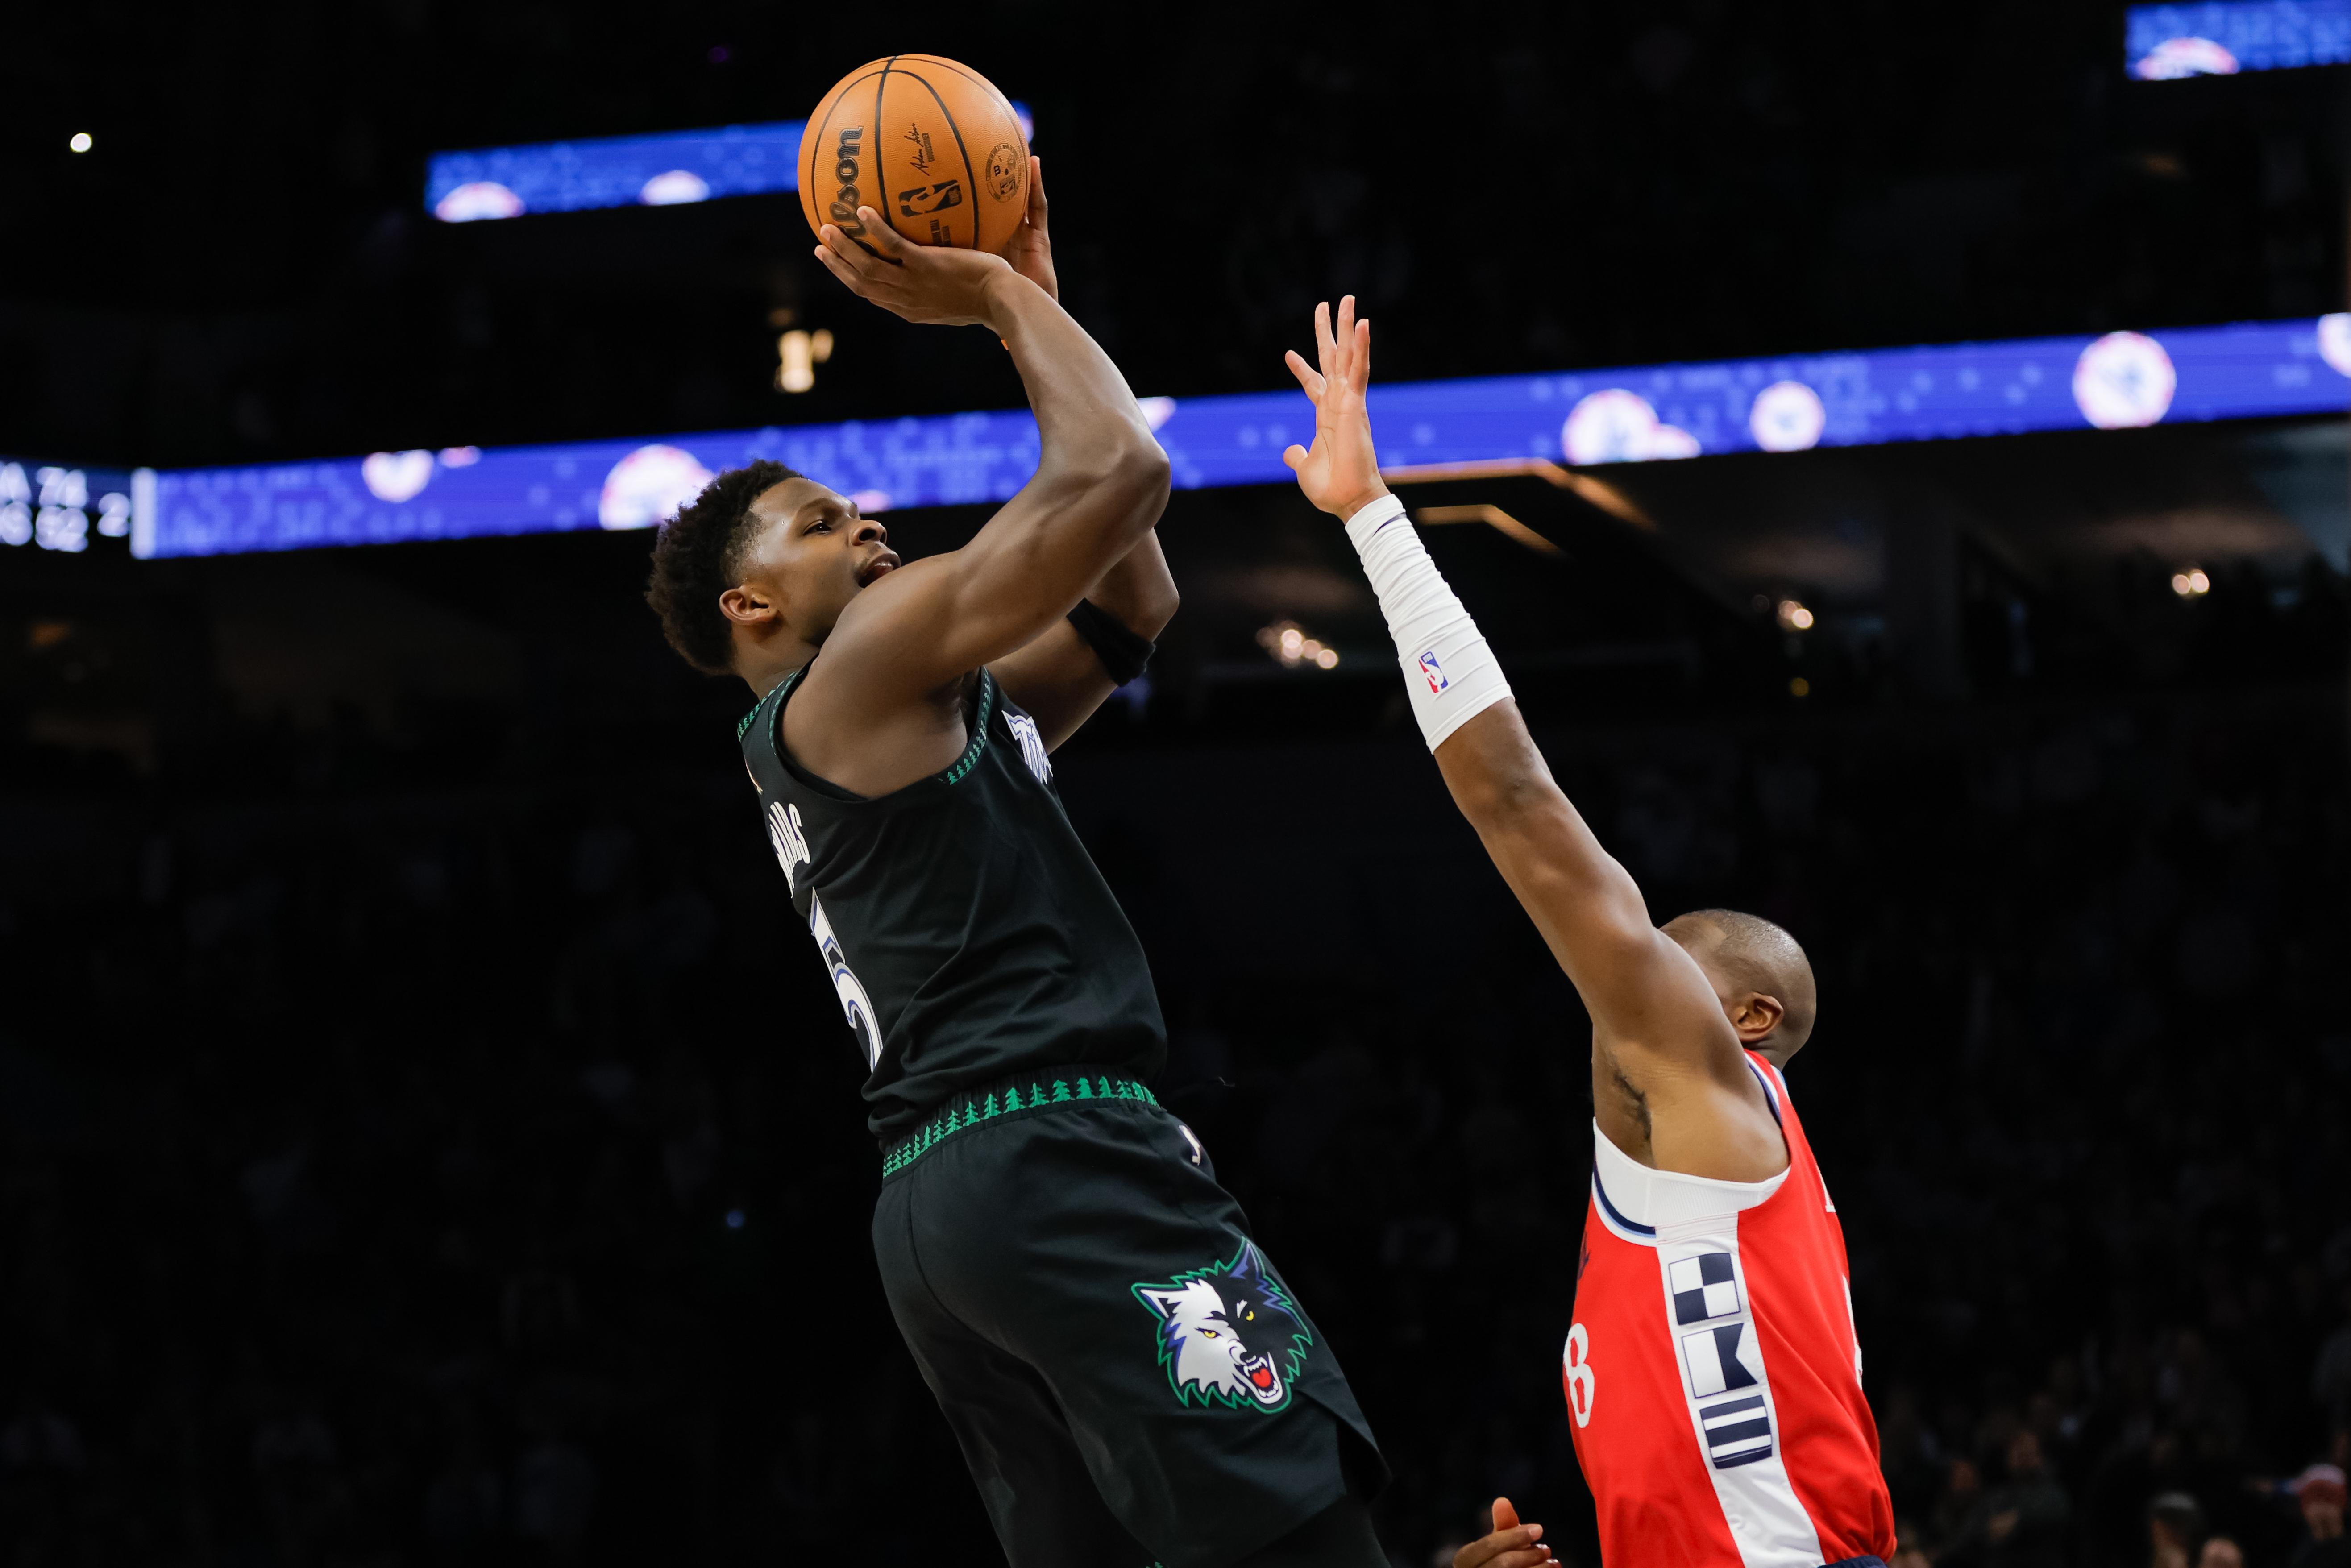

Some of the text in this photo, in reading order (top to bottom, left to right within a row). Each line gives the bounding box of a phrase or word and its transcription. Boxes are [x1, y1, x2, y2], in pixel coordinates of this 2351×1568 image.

[829, 126, 876, 252] ilson
[36, 466, 88, 509] 74
[97, 492, 130, 537] 2
[1563, 1323, 1595, 1428] 8
